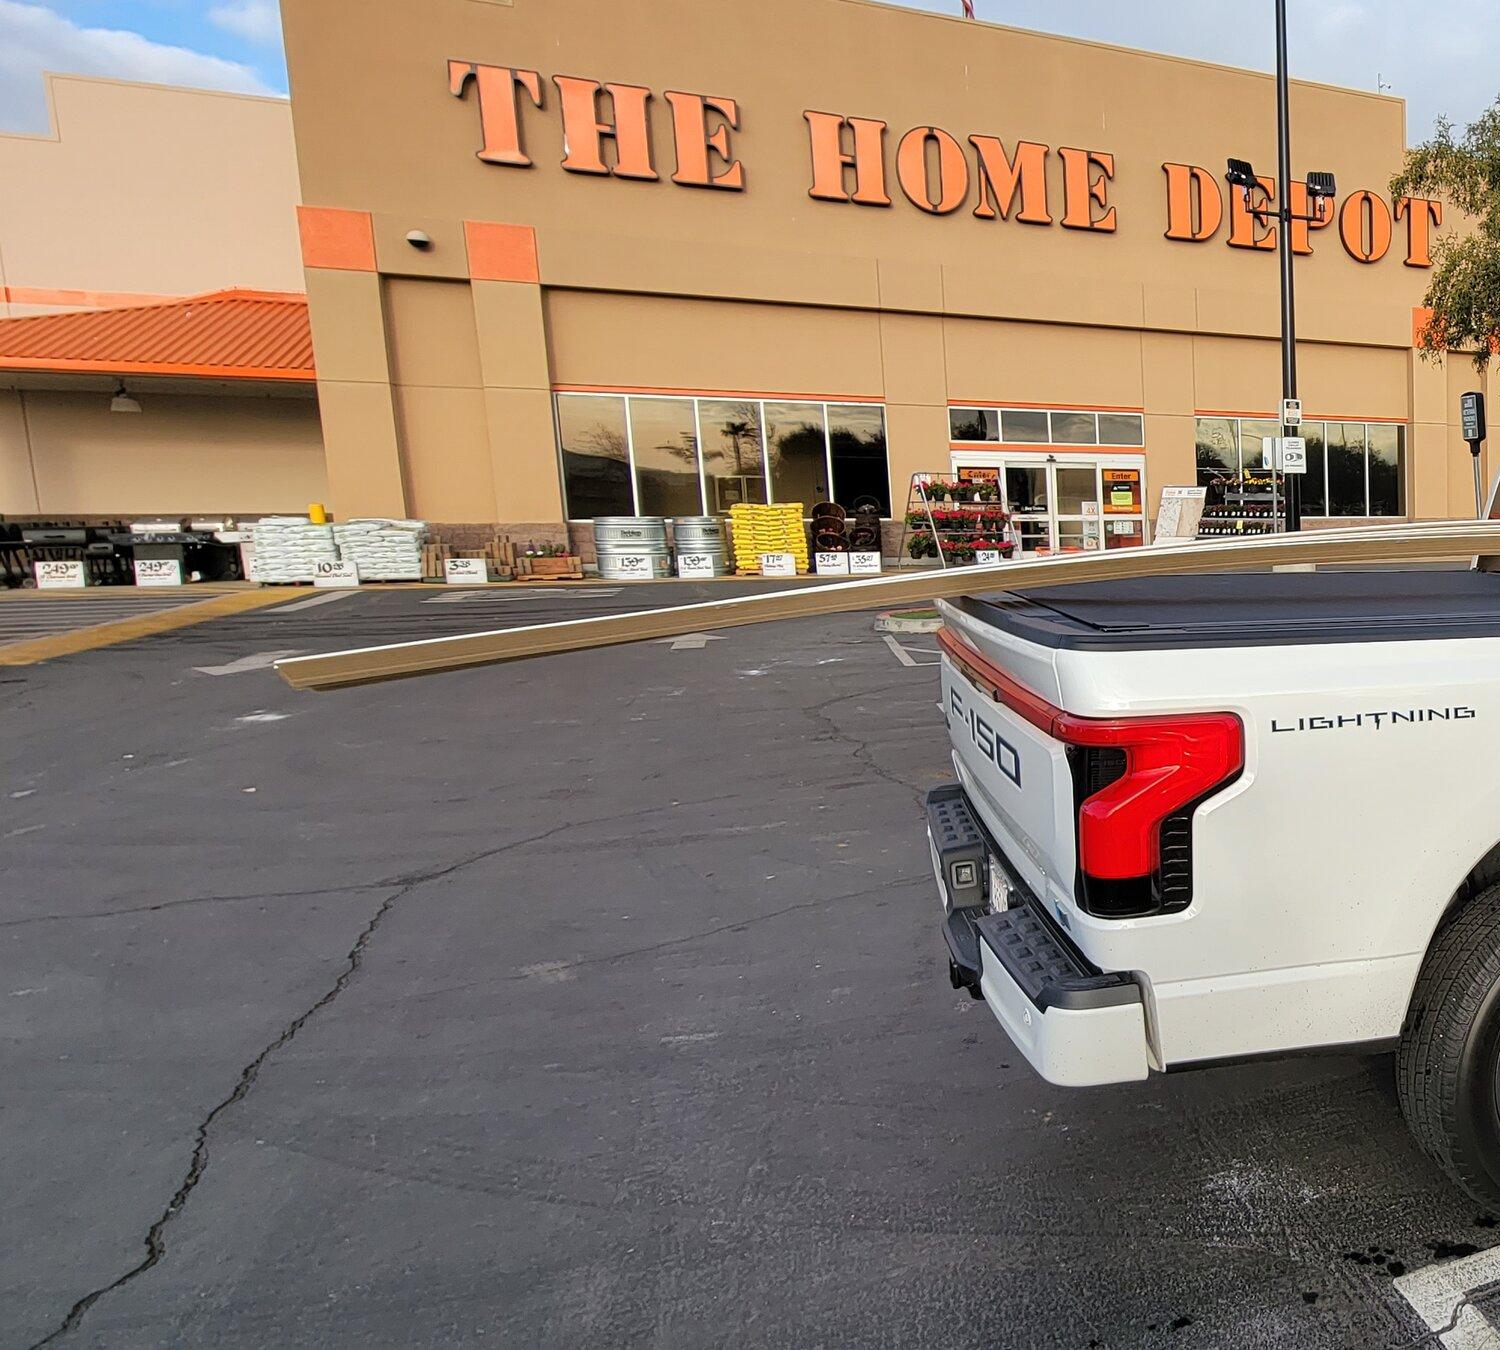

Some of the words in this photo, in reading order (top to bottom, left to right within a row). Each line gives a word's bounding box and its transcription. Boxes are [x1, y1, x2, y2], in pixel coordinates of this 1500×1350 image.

[447, 58, 746, 192] THE
[802, 109, 1118, 235] HOME
[1161, 161, 1443, 269] DEPOT
[1111, 472, 1132, 480] Enter
[950, 685, 1022, 790] F-150
[1271, 706, 1476, 733] LIGHTNING
